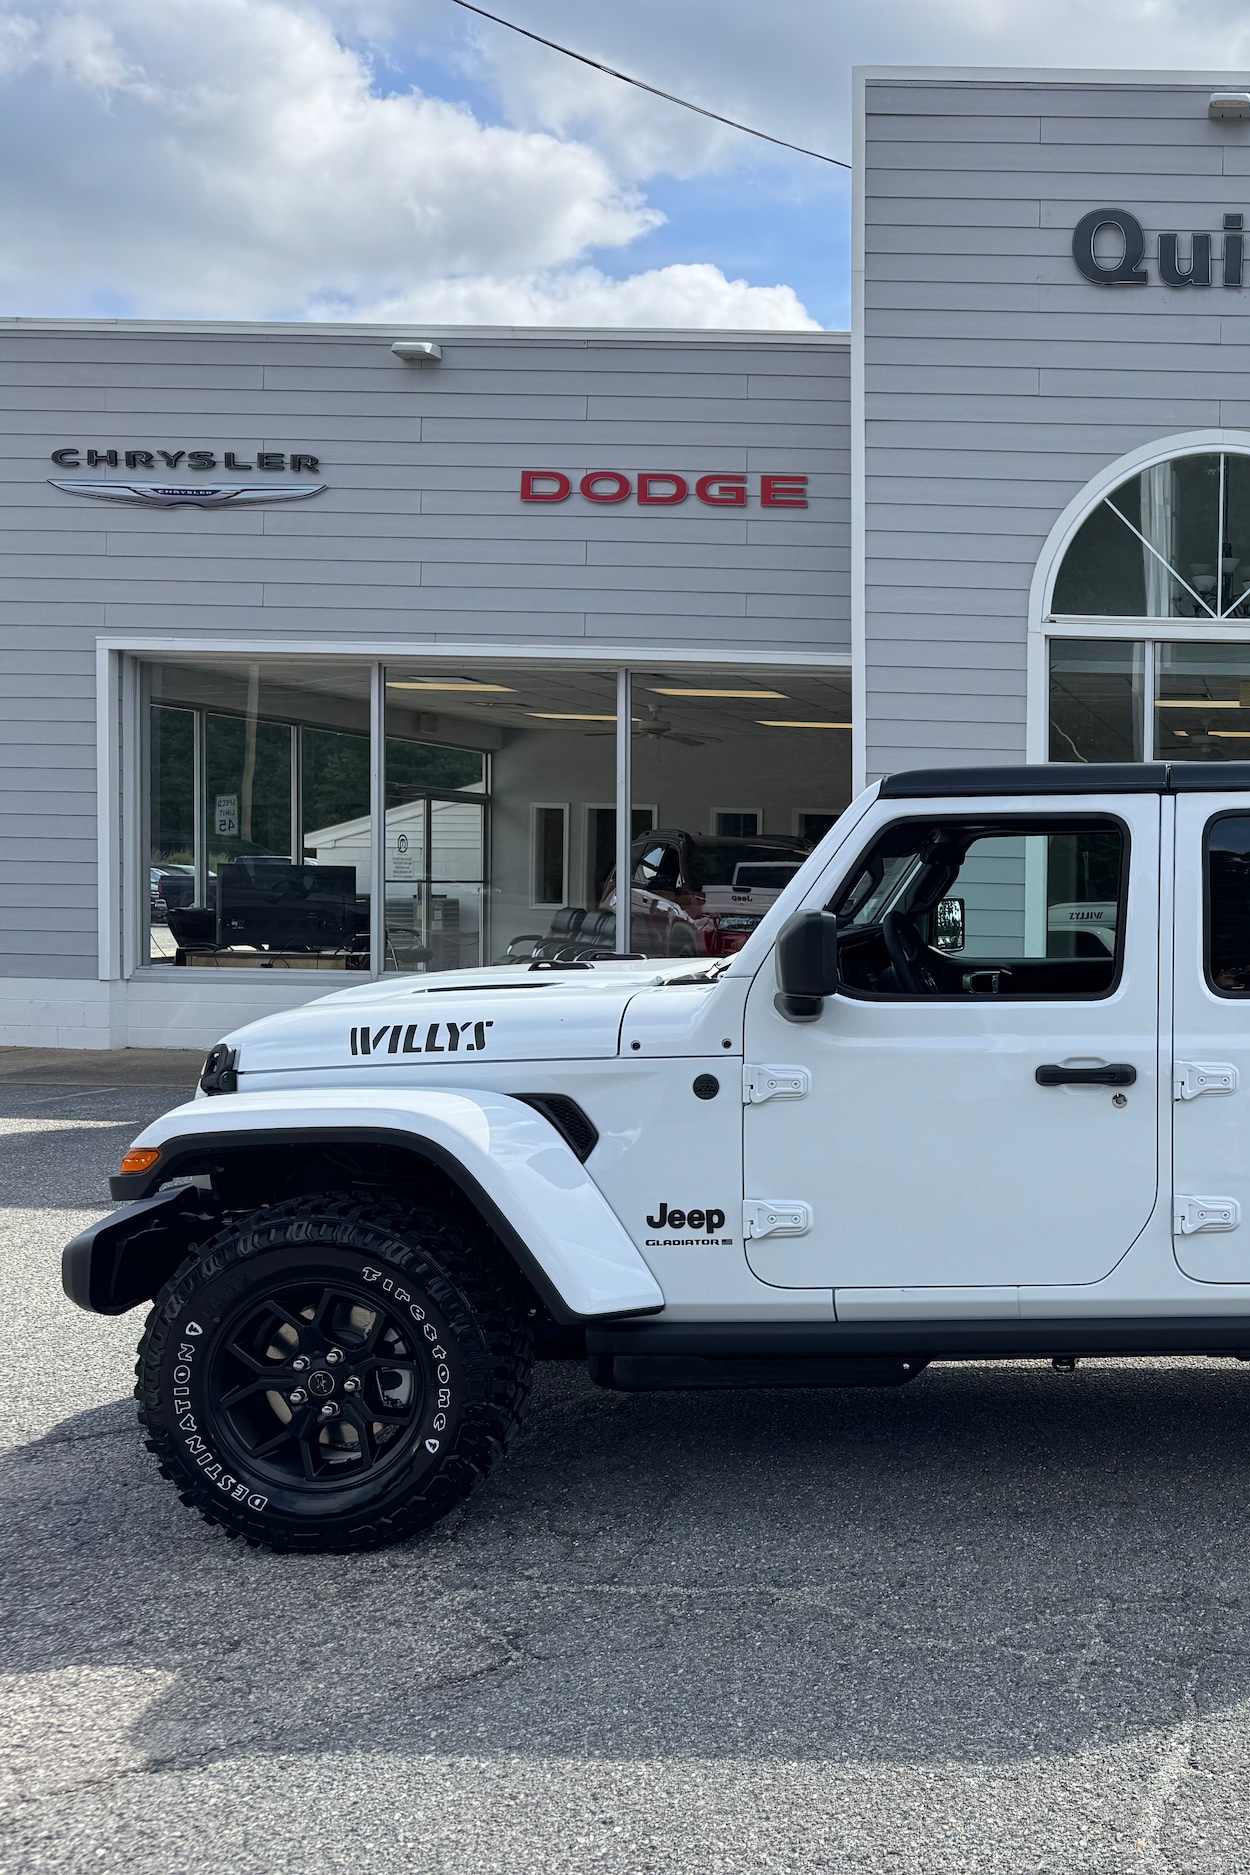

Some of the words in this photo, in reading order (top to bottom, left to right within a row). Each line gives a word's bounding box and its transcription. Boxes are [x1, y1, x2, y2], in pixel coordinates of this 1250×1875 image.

[51, 448, 320, 473] CHRYSLER
[520, 470, 808, 508] DODGE
[351, 1021, 494, 1056] WILLYS
[646, 1202, 725, 1234] Jeep
[362, 1266, 451, 1432] Firestone
[173, 1342, 269, 1512] DESTINATION
